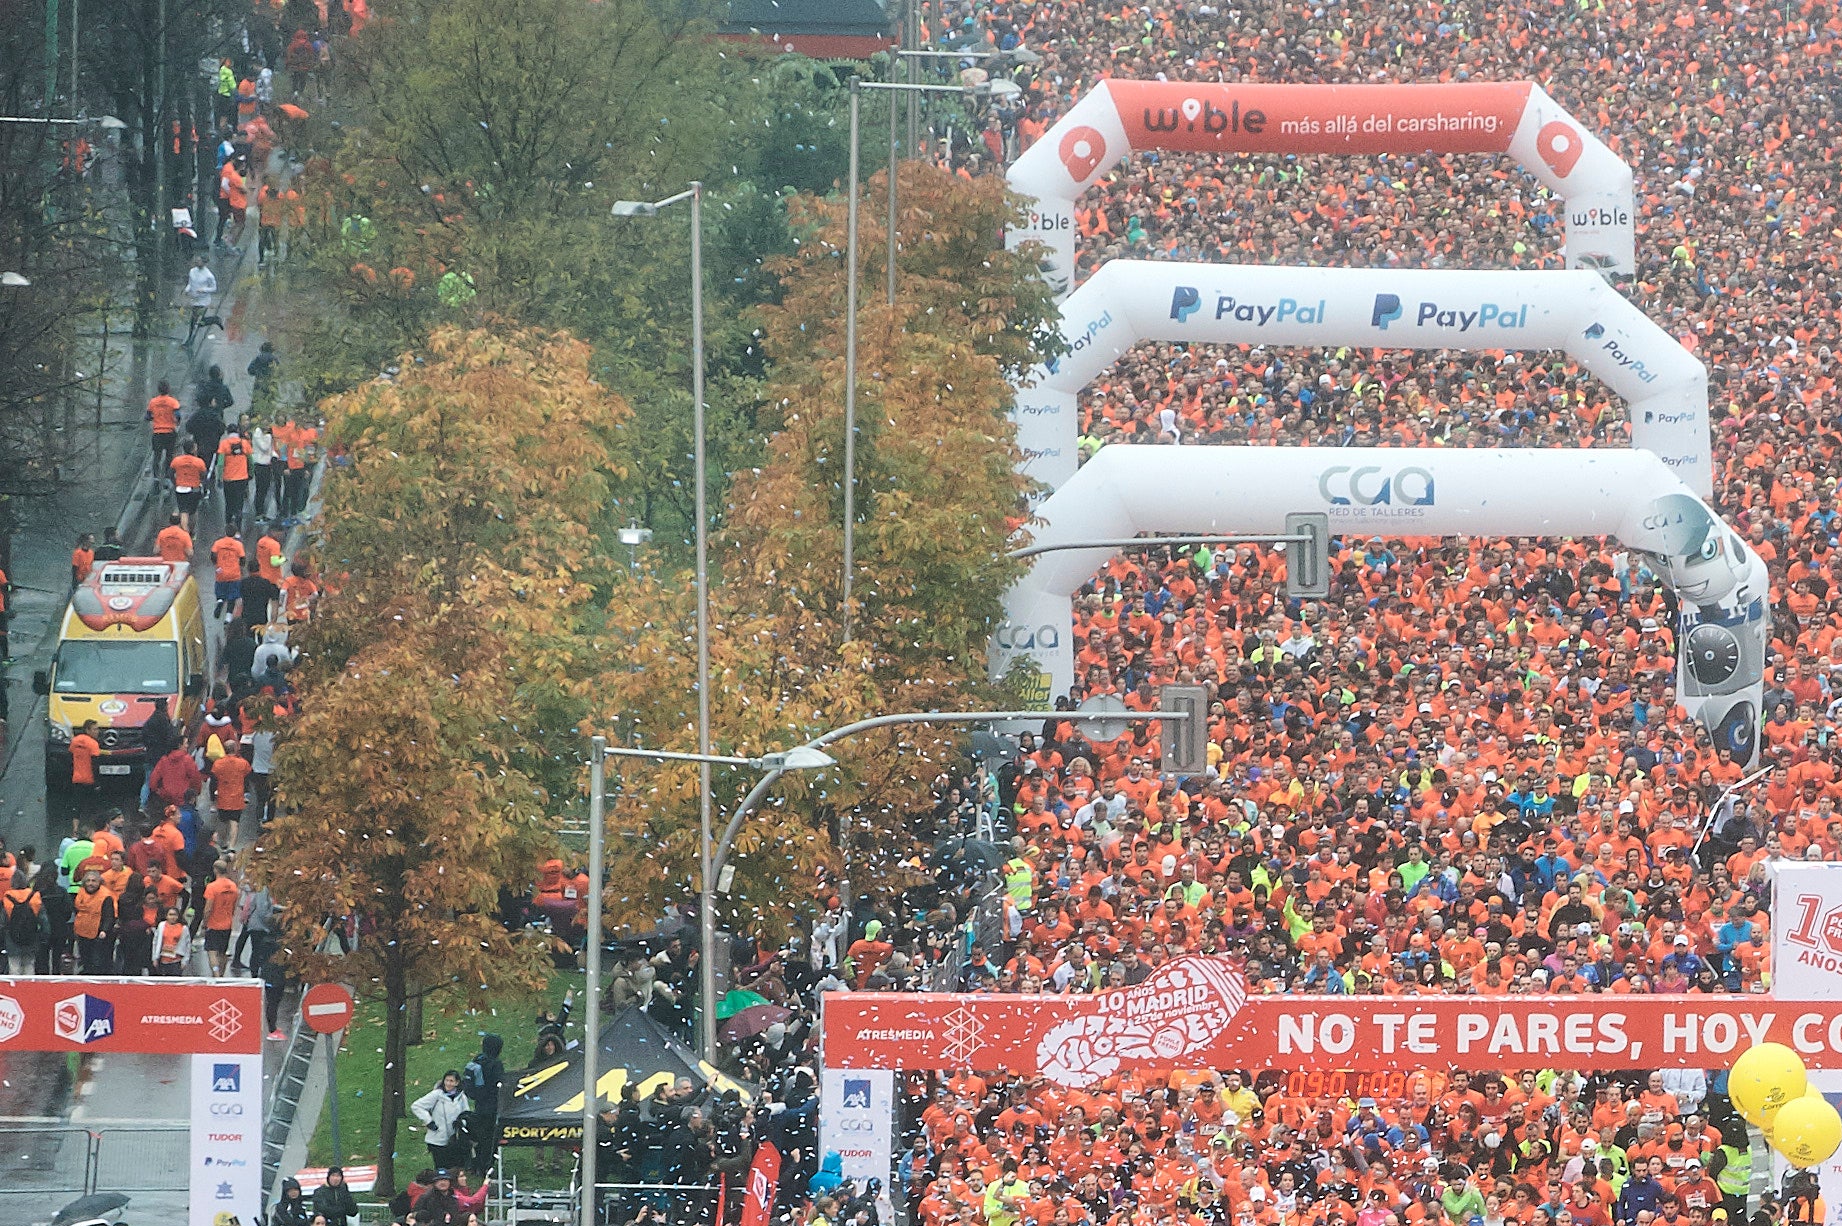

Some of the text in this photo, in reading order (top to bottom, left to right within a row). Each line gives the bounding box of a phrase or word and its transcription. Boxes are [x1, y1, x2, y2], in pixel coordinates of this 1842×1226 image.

[1143, 98, 1267, 134] wible
[1281, 108, 1498, 134] más allá del carsharing
[1572, 207, 1628, 226] wible
[1215, 295, 1326, 327] PayPal
[1417, 302, 1528, 332] PayPal
[1603, 340, 1658, 383] PayPal
[1022, 404, 1060, 415] PayPal
[1658, 411, 1695, 424] PayPal
[1329, 507, 1425, 517] RED DE TALLERES
[1126, 985, 1156, 1000] AÑOS
[1097, 985, 1209, 1017] 10 MADRID
[141, 1015, 203, 1025] ATRESMEDIA
[1134, 1000, 1219, 1025] 25 de noviembre
[856, 1029, 935, 1041] ATRESMEDIA
[1278, 1013, 1356, 1054] NO
[1372, 1013, 1438, 1054] TE
[1456, 1013, 1643, 1060] PARES,
[1663, 1012, 1777, 1054] HOY
[213, 1077, 237, 1092] AXA
[208, 1133, 243, 1142] TUDOR
[838, 1149, 873, 1158] TUDOR
[216, 1159, 247, 1167] PayPal
